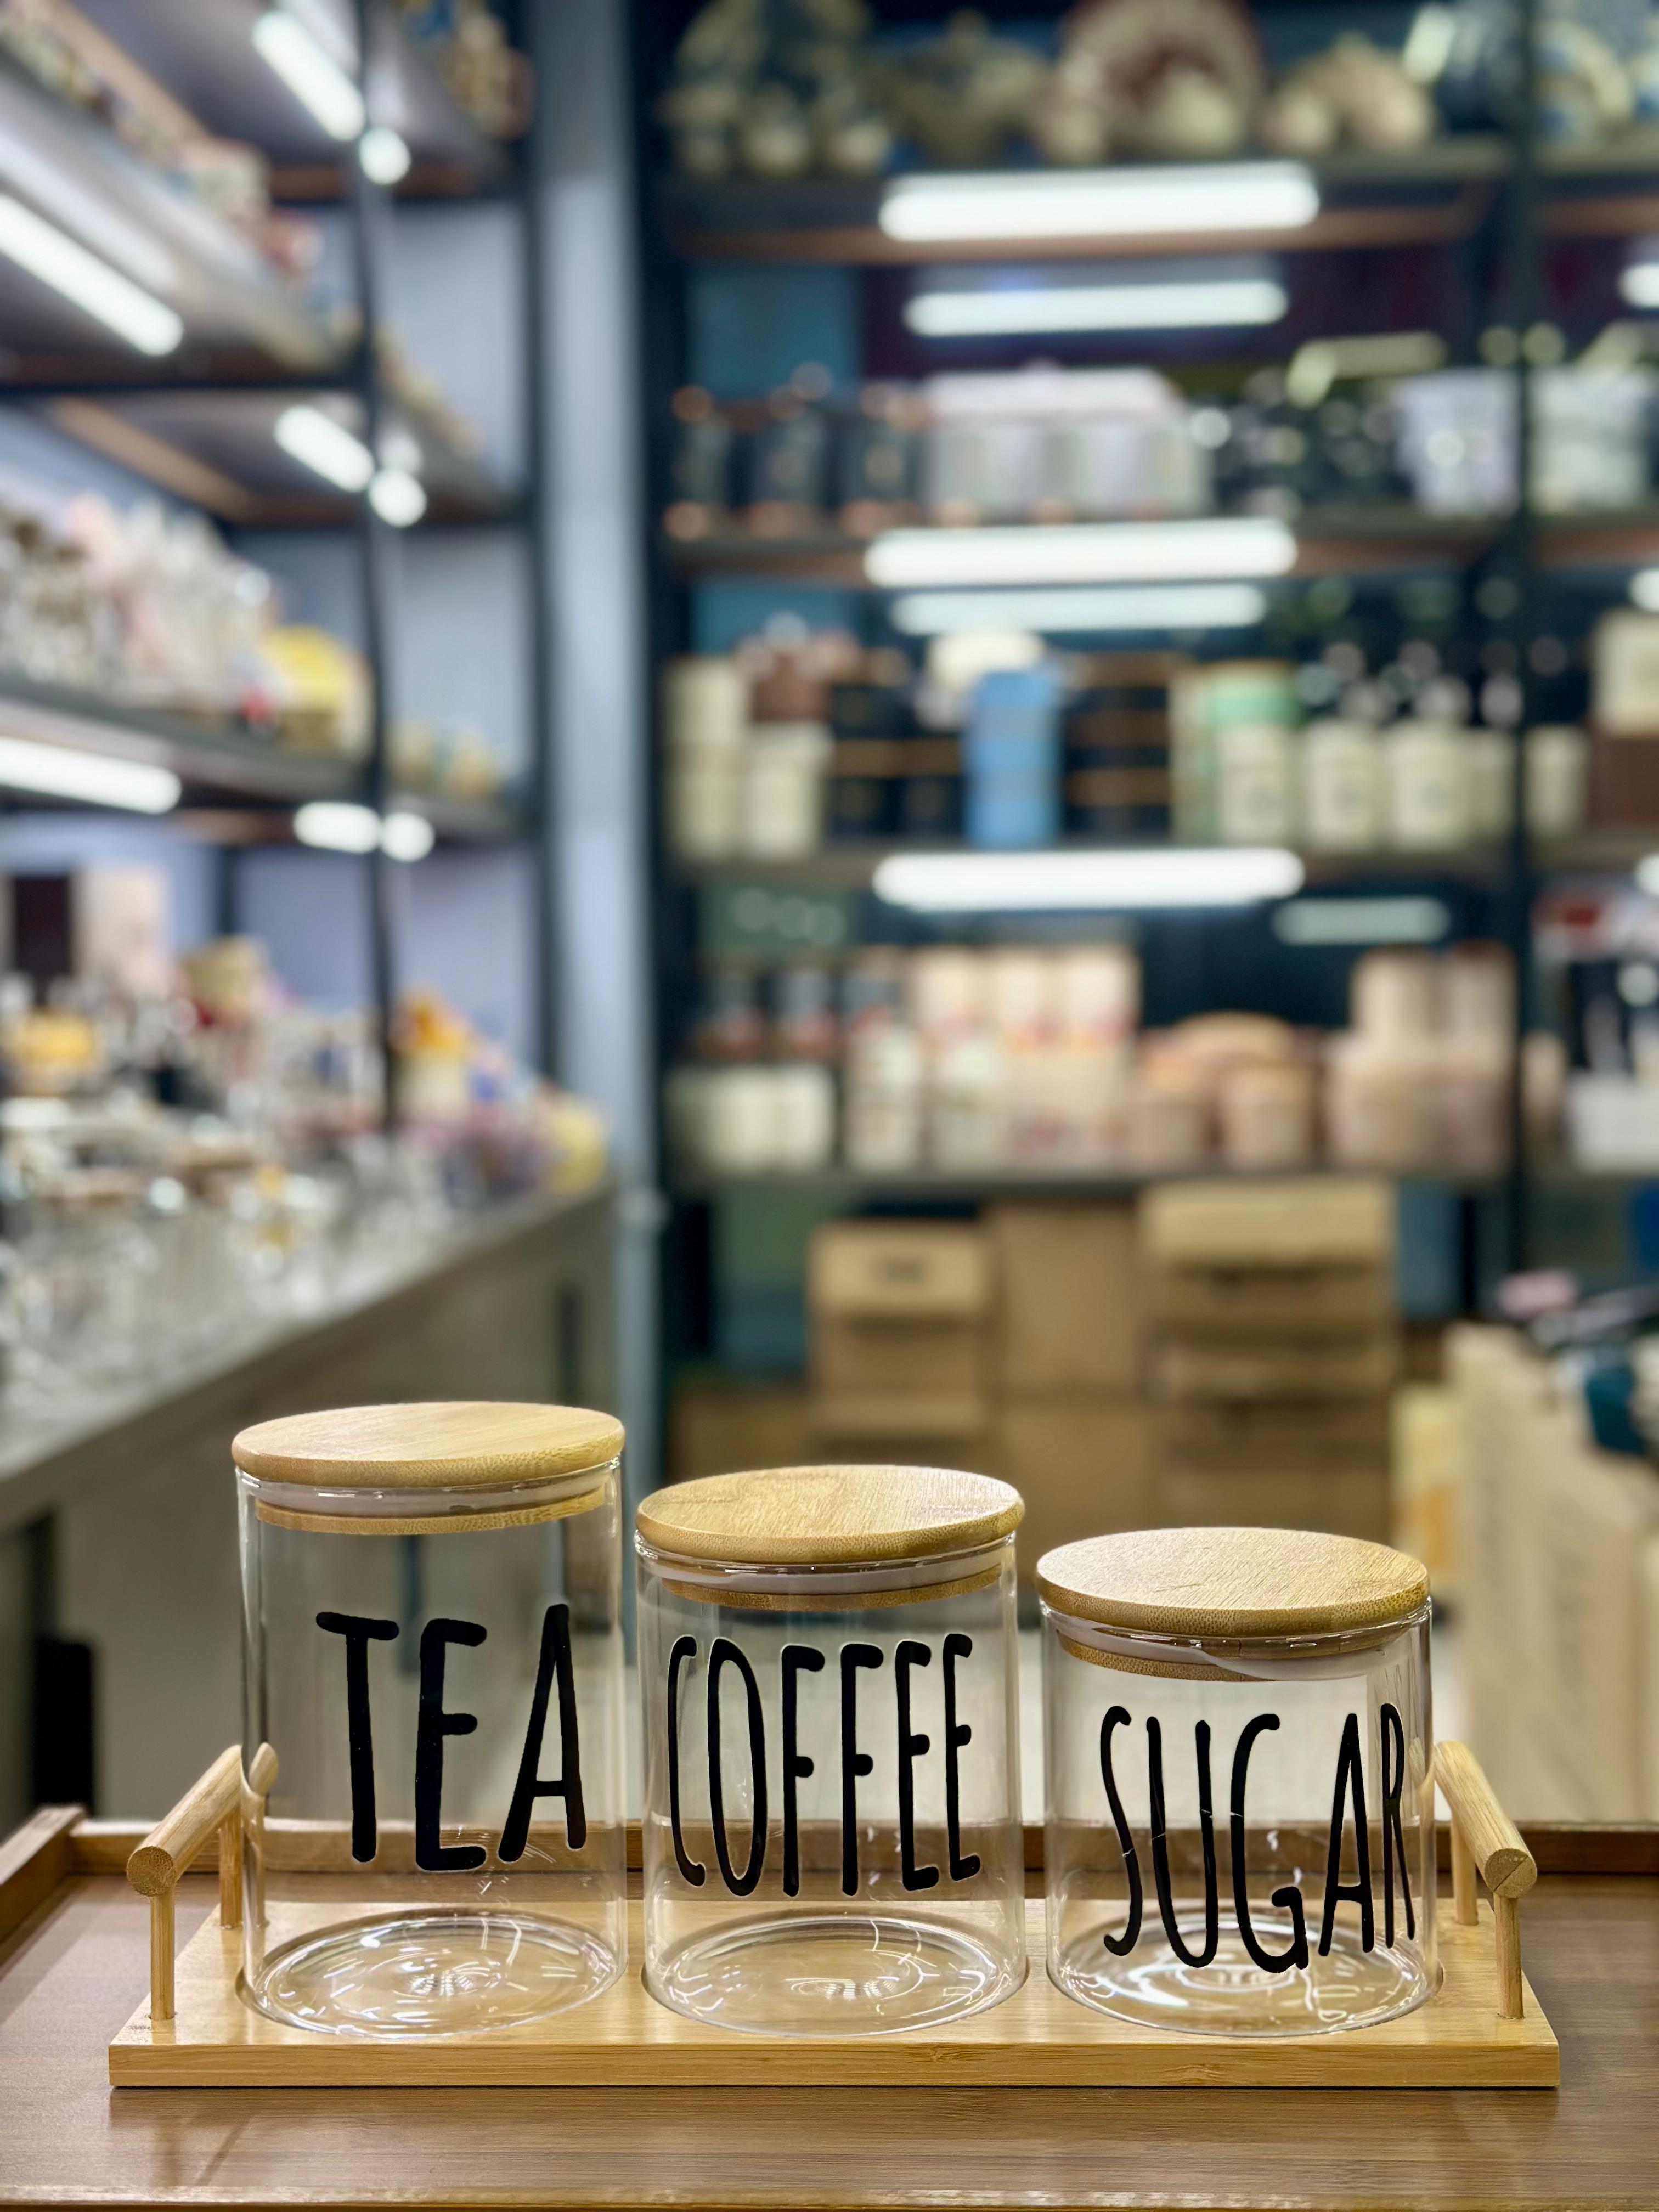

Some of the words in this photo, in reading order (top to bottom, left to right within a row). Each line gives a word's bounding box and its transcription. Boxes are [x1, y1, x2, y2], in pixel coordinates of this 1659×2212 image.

[316, 1603, 587, 1872] TEA
[668, 1634, 981, 1898] COFFEE
[1101, 1703, 1415, 1973] SUGAR
